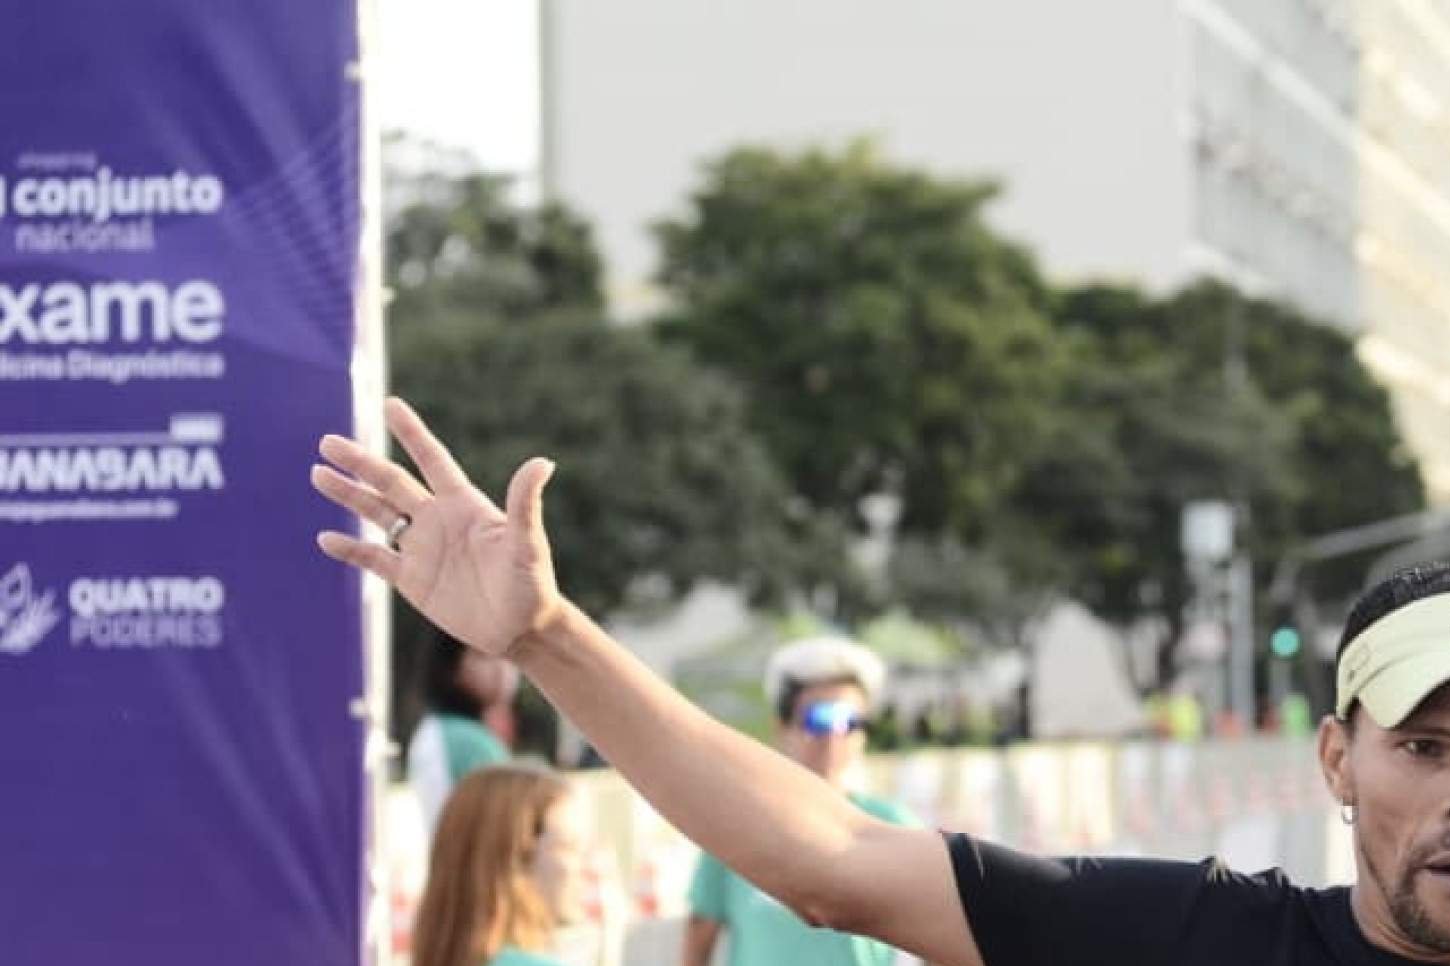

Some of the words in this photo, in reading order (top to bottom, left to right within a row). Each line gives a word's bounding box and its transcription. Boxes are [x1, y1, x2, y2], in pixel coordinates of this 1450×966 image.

[13, 167, 224, 222] conjunto
[15, 217, 153, 252] nacional
[68, 576, 225, 619] QUATRO
[69, 613, 224, 648] PODERES
